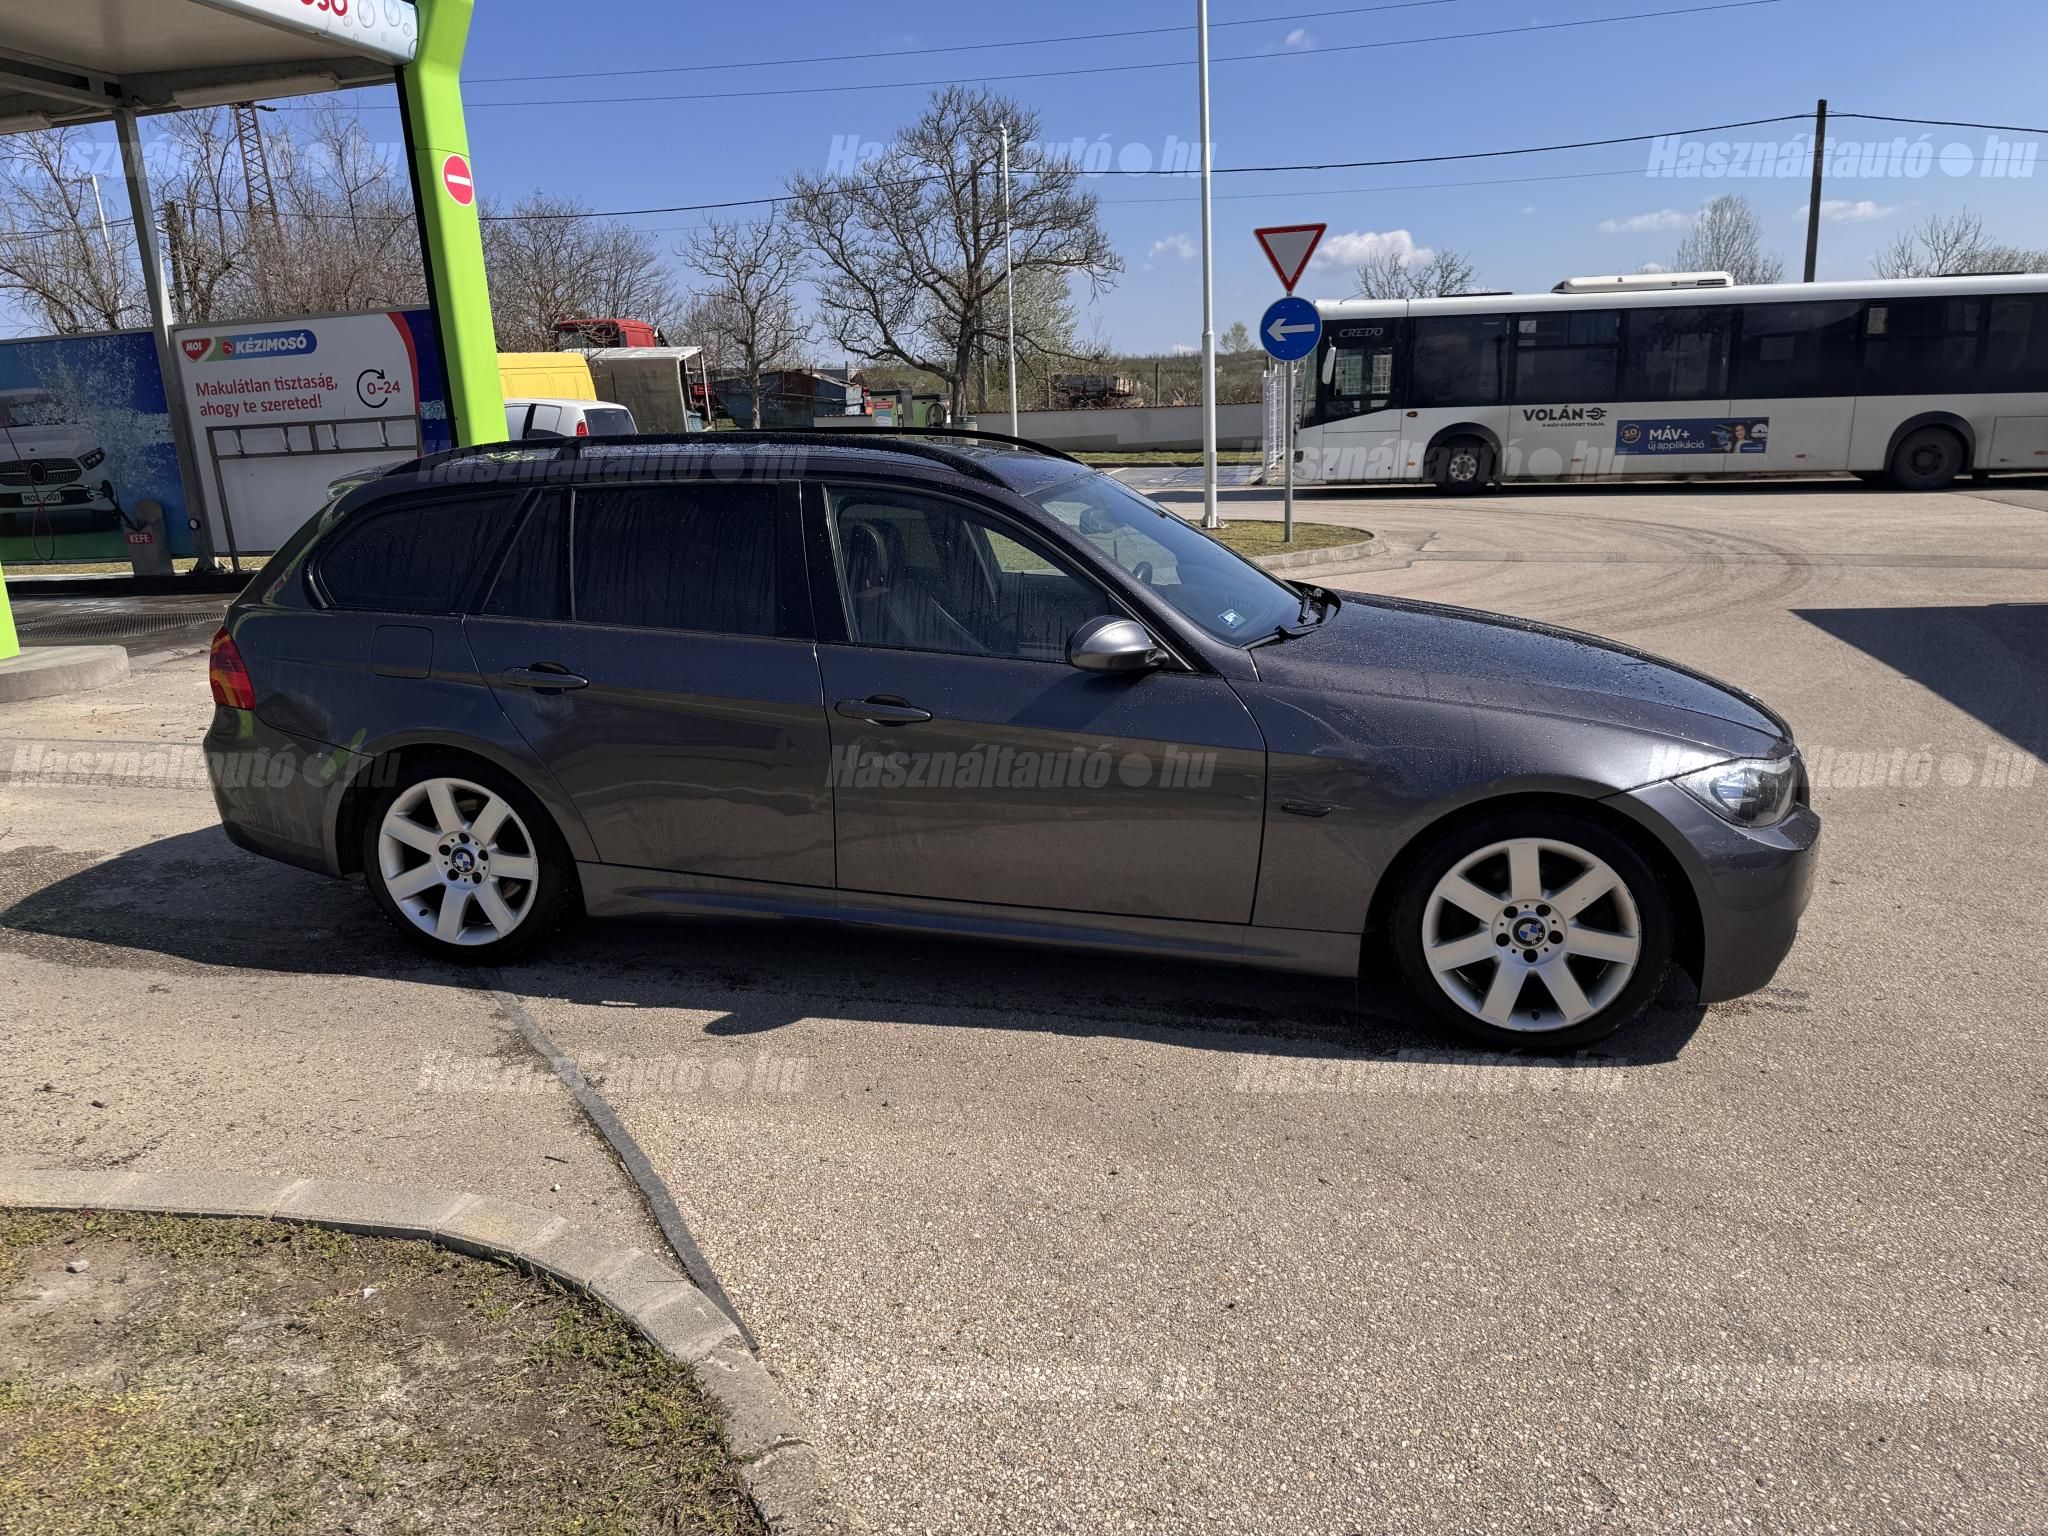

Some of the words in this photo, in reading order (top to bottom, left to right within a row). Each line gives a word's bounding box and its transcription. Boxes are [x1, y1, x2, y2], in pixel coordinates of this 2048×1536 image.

[1339, 327, 1384, 338] CREDO
[186, 341, 203, 352] MOL
[235, 333, 308, 354] KÉZIMOSÓ
[195, 376, 271, 398] Makulátlan
[274, 372, 338, 393] tisztaság,
[366, 380, 401, 396] 0-24
[199, 400, 240, 419] ahogy
[243, 399, 257, 414] te
[262, 394, 323, 413] szereted!
[1522, 405, 1584, 421] VOLÁN
[1649, 425, 1691, 440] MÁV+
[1647, 441, 1657, 451] új
[1657, 439, 1705, 451] applikáció
[129, 533, 150, 544] KEFE
